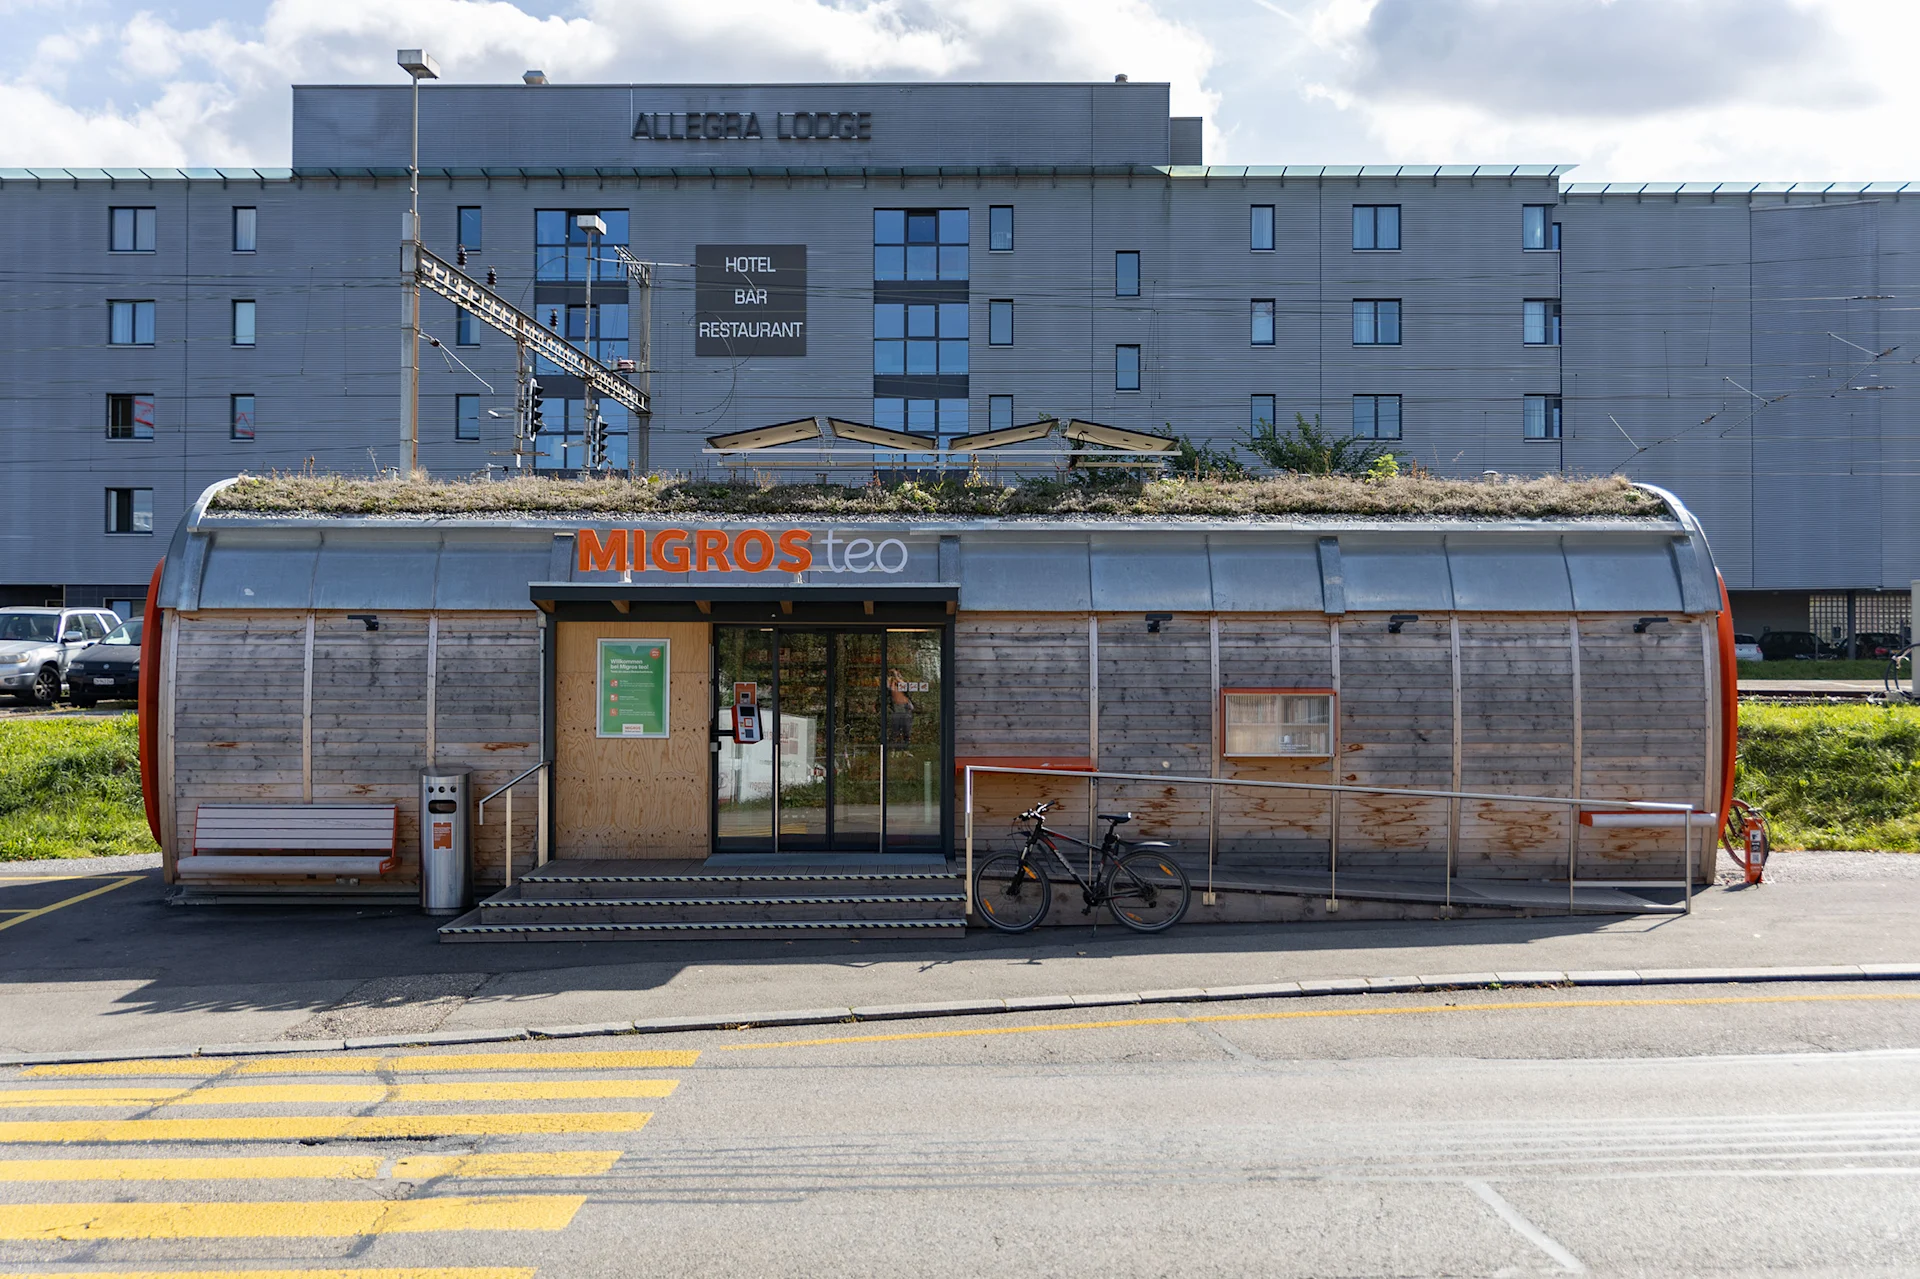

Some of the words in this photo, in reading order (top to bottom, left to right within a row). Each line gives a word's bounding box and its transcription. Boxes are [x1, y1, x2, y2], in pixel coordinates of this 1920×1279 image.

[632, 112, 763, 139] ALLEGRA
[777, 112, 871, 139] LODGE
[725, 257, 776, 272] HOTEL
[735, 289, 767, 304] BAR
[699, 322, 803, 337] RESTAURANT
[578, 529, 812, 573] MIGROS
[820, 530, 908, 574] teo
